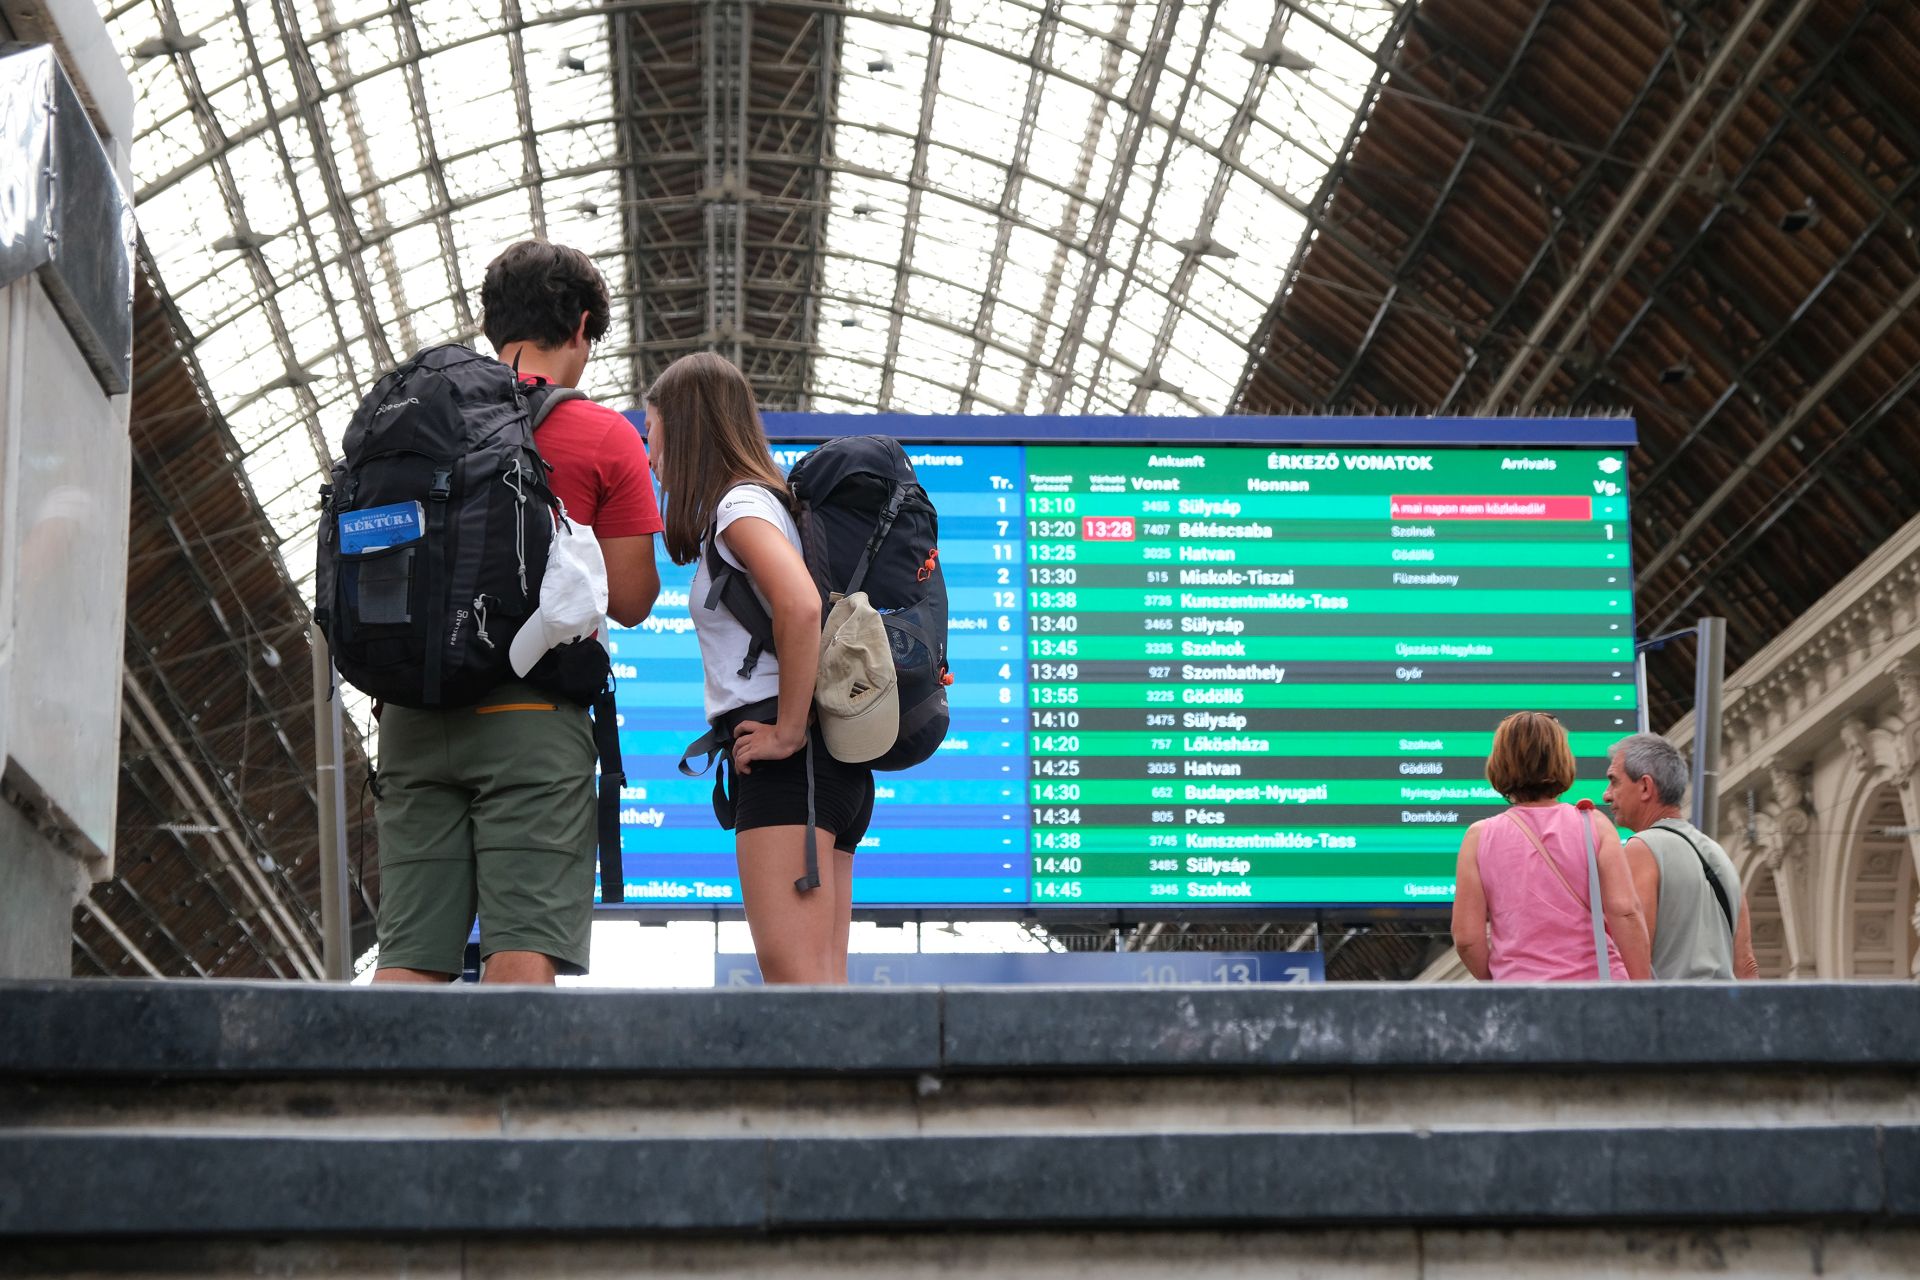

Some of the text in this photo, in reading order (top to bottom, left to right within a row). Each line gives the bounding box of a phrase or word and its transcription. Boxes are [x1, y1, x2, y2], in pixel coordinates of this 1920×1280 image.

[1148, 455, 1205, 467] Ankunft
[1268, 452, 1433, 470] ÉRKEZŐ VONATOK
[1501, 458, 1556, 470] Arrivals
[990, 476, 1013, 489] Tr.
[1131, 477, 1309, 491] Vonat Honnan
[1593, 480, 1621, 496] Vg.
[998, 498, 1006, 512] 1
[1030, 498, 1075, 513] 13:10
[1179, 499, 1241, 517] Sülysáp
[1391, 503, 1399, 514] A
[343, 513, 414, 534] KÉKTÚRA
[997, 521, 1008, 536] 7
[1030, 521, 1613, 540] 13:20 13:28 7407 Békéscsaba Szolnok 1
[993, 544, 1011, 560] 11
[1031, 545, 1076, 560] 13:25
[1180, 546, 1235, 561] Hatvan
[998, 568, 1009, 584] 2
[1030, 568, 1076, 584] 13:30
[1147, 571, 1168, 582] 515
[1180, 569, 1294, 585] Miskolc-Tiszai
[1393, 573, 1459, 586] Füzesabony
[994, 592, 1015, 608] 12
[1031, 592, 1076, 608] 13:38
[1181, 593, 1348, 608] Kunszentmiklós-Tass
[998, 616, 1010, 631] 6
[1031, 616, 1077, 632] 13:40
[1181, 616, 1244, 635] Sülysáp
[1032, 640, 1078, 655] 13:45
[1182, 641, 1245, 656] Szolnok
[999, 664, 1011, 679] 4
[1032, 664, 1078, 679] 13:49
[1149, 667, 1170, 677] 927
[1182, 664, 1285, 683] Szombathely
[1396, 667, 1423, 680] Győr
[999, 688, 1011, 703] 8
[1032, 688, 1078, 703] 13:55
[1147, 691, 1174, 701] 3225
[1183, 688, 1244, 703] Gödöllő
[1032, 712, 1079, 727] 14:10
[1147, 715, 1175, 725] 3475
[1183, 712, 1247, 731] Sülysáp
[1033, 736, 1079, 751] 14:20
[1184, 736, 1269, 751] Lőkösháza
[1400, 739, 1443, 750] Szolnok
[1033, 760, 1079, 776] 14:25
[1148, 763, 1176, 774] 3035
[1184, 761, 1241, 775] Hatvan
[1034, 784, 1080, 800] 14:30
[1185, 784, 1327, 803] Budapest-Nyugati
[1033, 808, 1459, 824] 14:34 805 Pécs Dombóvár
[1034, 833, 1080, 848] 14:38
[1186, 833, 1356, 848] Kunszentmiklós-Tass
[1035, 857, 1081, 873] 14:40
[1186, 857, 1250, 876] Sülysáp
[1035, 882, 1082, 897] 14:45
[1188, 882, 1251, 896] Szolnok
[1142, 965, 1176, 984] 10
[1215, 965, 1250, 984] 13
